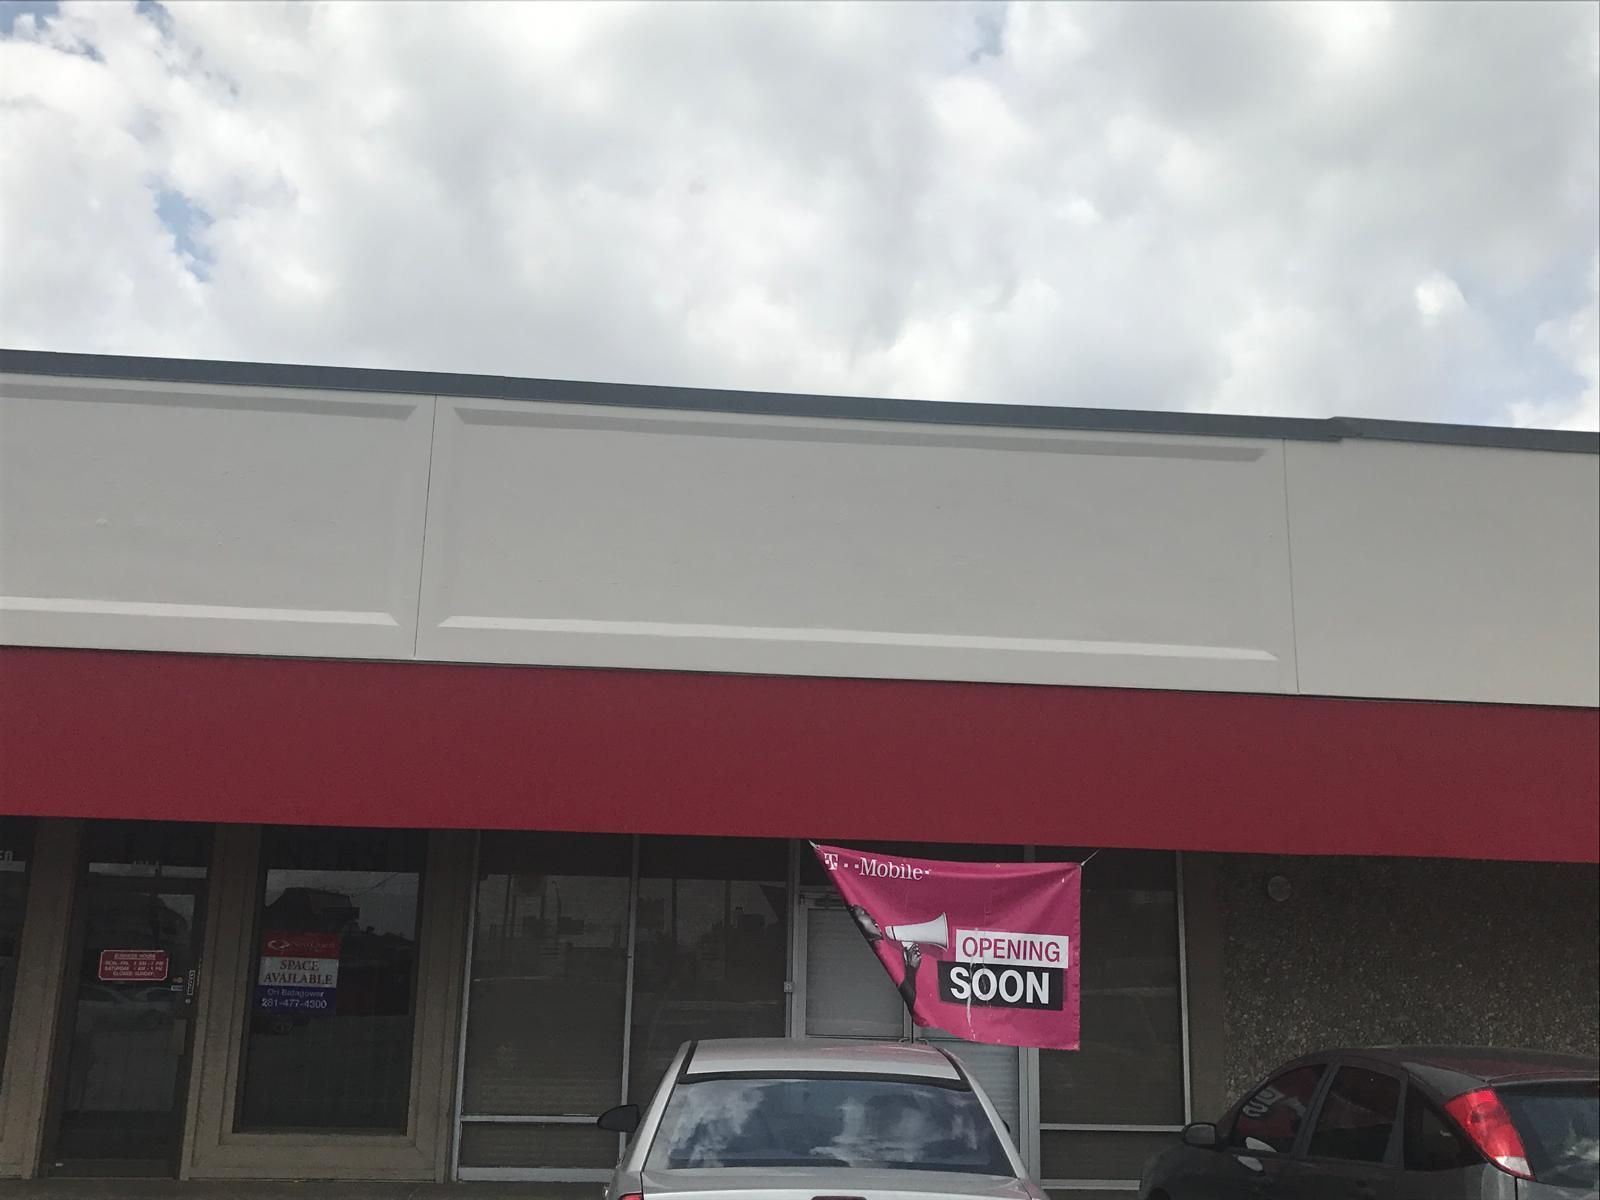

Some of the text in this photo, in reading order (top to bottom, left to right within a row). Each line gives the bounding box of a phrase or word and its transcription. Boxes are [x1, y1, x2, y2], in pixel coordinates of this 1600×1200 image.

[962, 936, 1061, 963] OPENING
[280, 959, 320, 971] SPACE
[263, 972, 333, 985] AVAILABLE
[949, 966, 1050, 1005] SOON
[261, 998, 328, 1009] 281-477-4300
